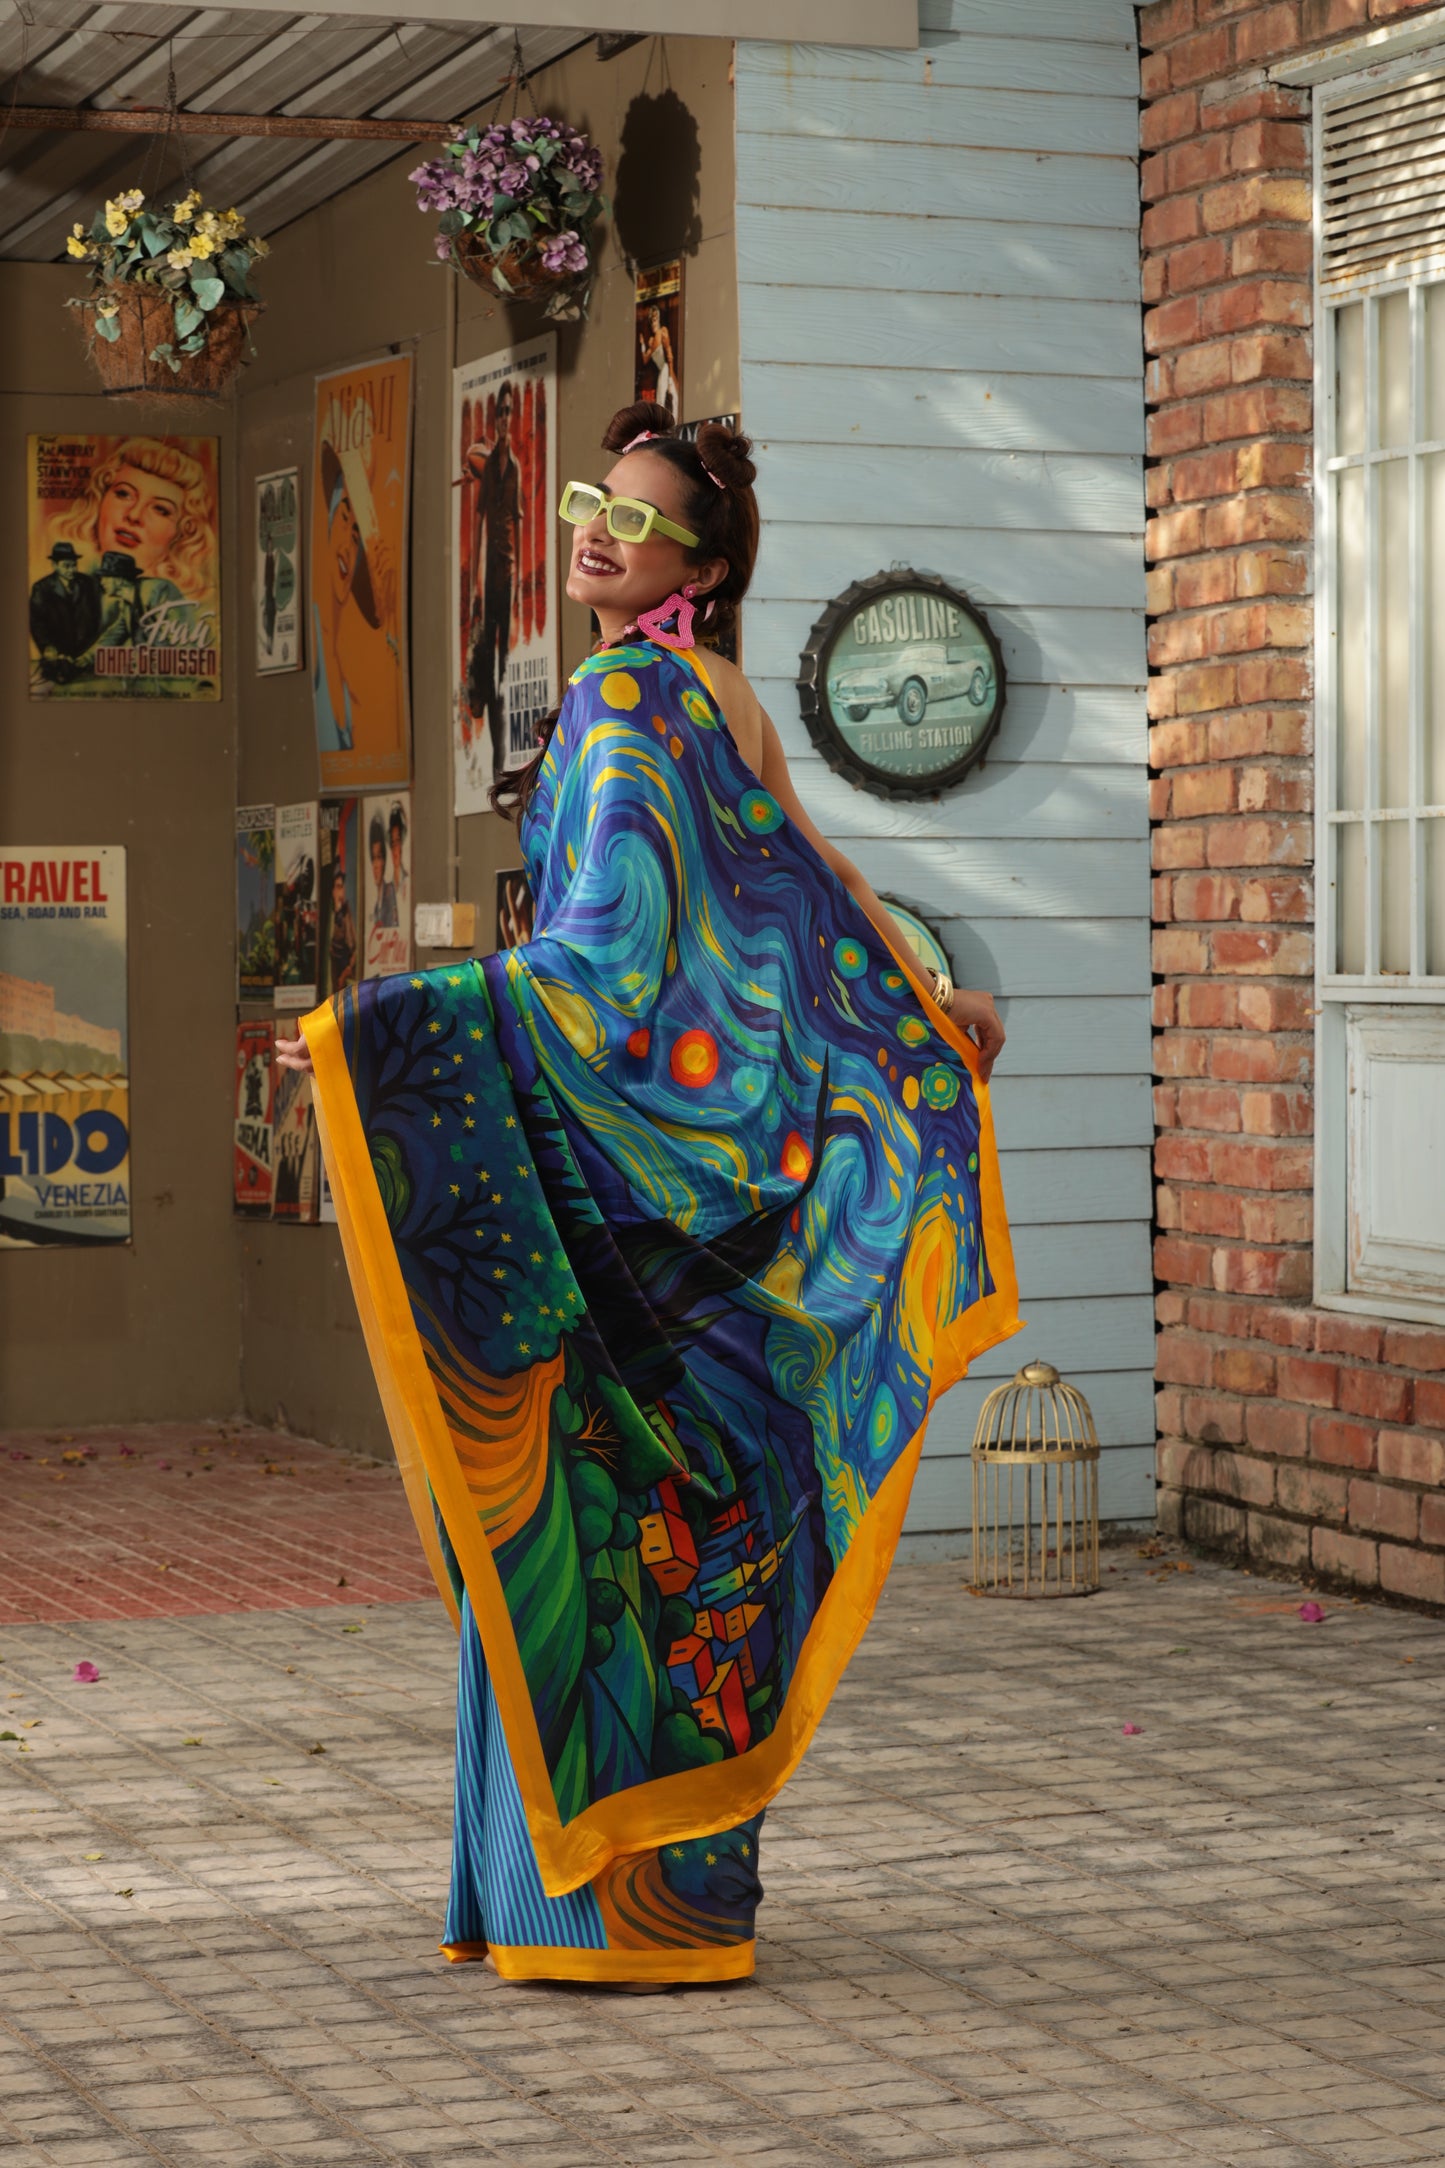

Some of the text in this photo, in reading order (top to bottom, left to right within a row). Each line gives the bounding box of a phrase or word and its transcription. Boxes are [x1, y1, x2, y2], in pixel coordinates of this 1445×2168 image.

[139, 600, 215, 649] Frau
[853, 596, 961, 646] GASOLINE
[509, 680, 548, 711] AMERICAN
[859, 726, 974, 752] FILLING STATION
[0, 861, 108, 903] RAVEL
[27, 906, 57, 919] ROAD
[58, 906, 82, 919] AND
[84, 906, 107, 919] RAIL
[0, 1110, 129, 1175] LIDO
[34, 1184, 128, 1208] VENEZIA
